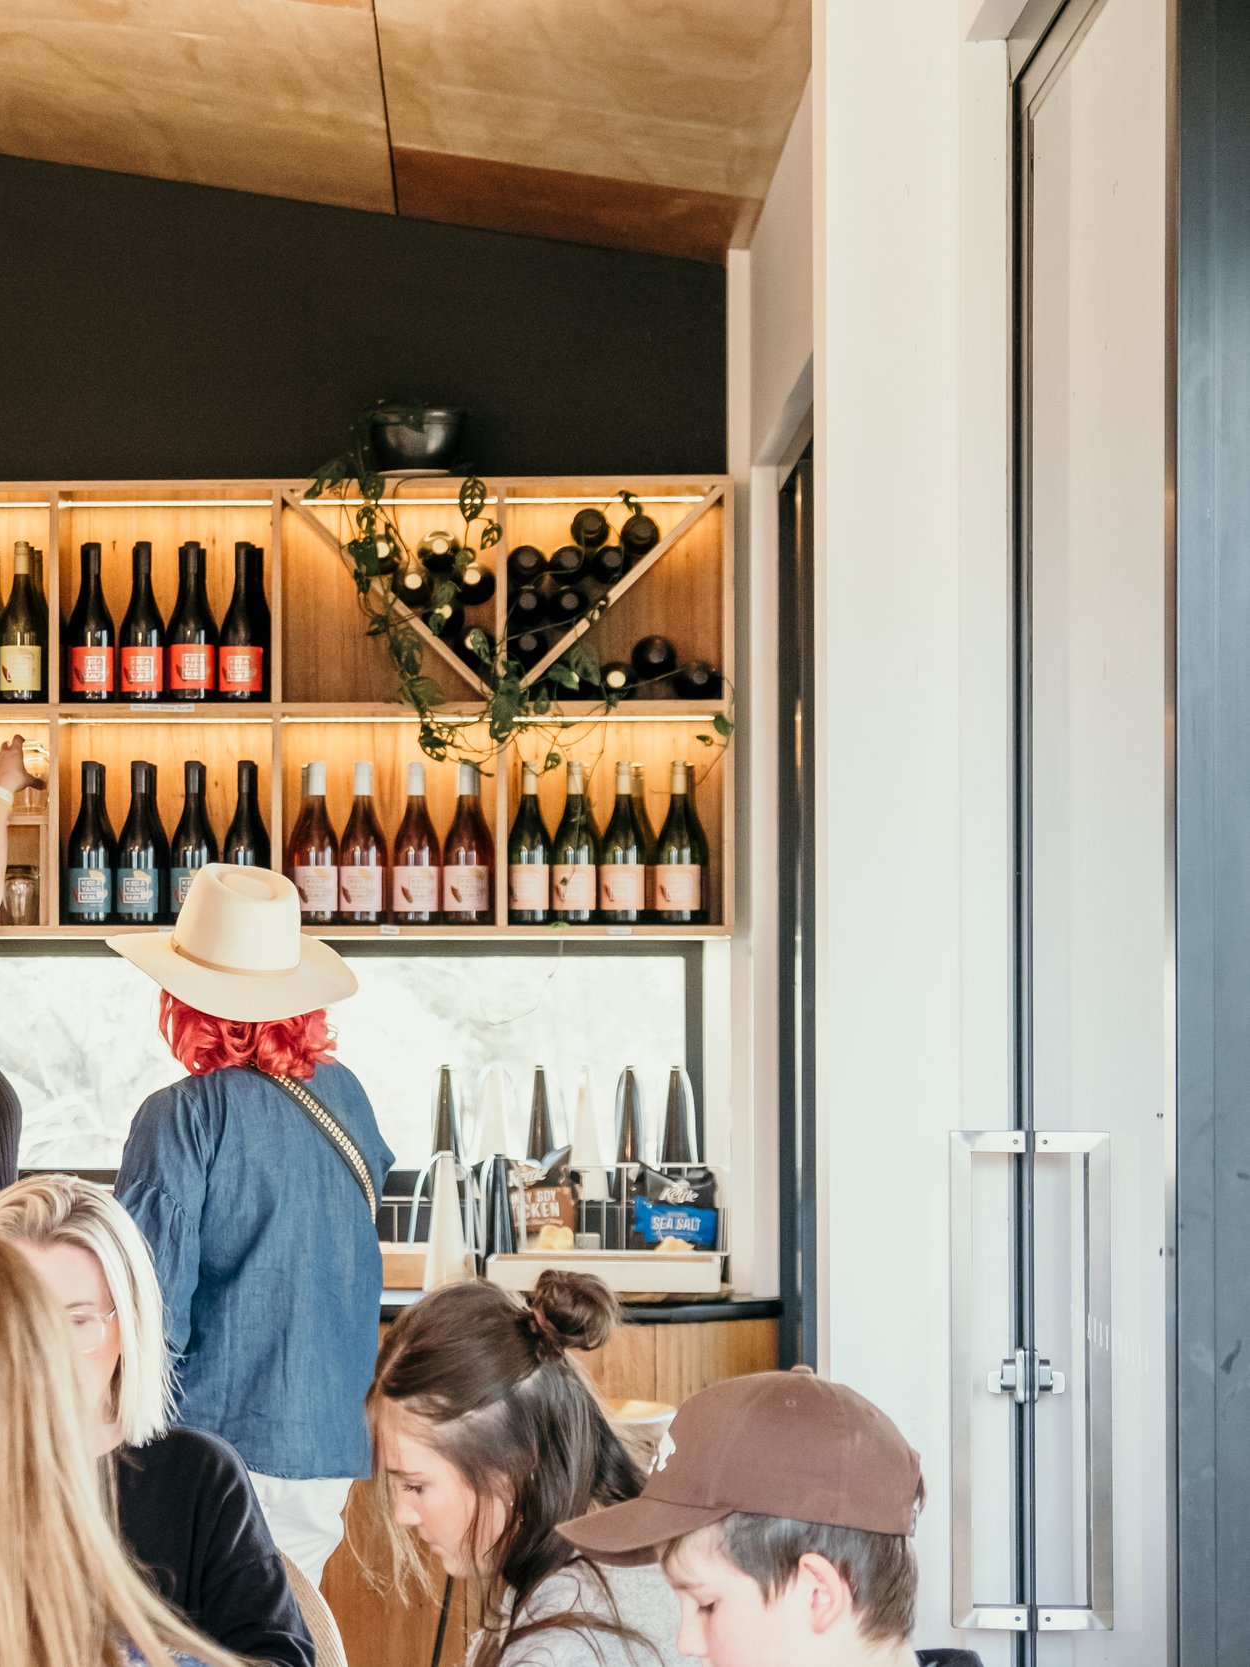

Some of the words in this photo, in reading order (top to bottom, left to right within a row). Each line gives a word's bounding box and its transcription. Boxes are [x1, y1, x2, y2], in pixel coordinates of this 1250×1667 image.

[537, 1190, 556, 1202] SOY
[652, 1216, 673, 1230] SEA
[676, 1217, 702, 1231] SALT
